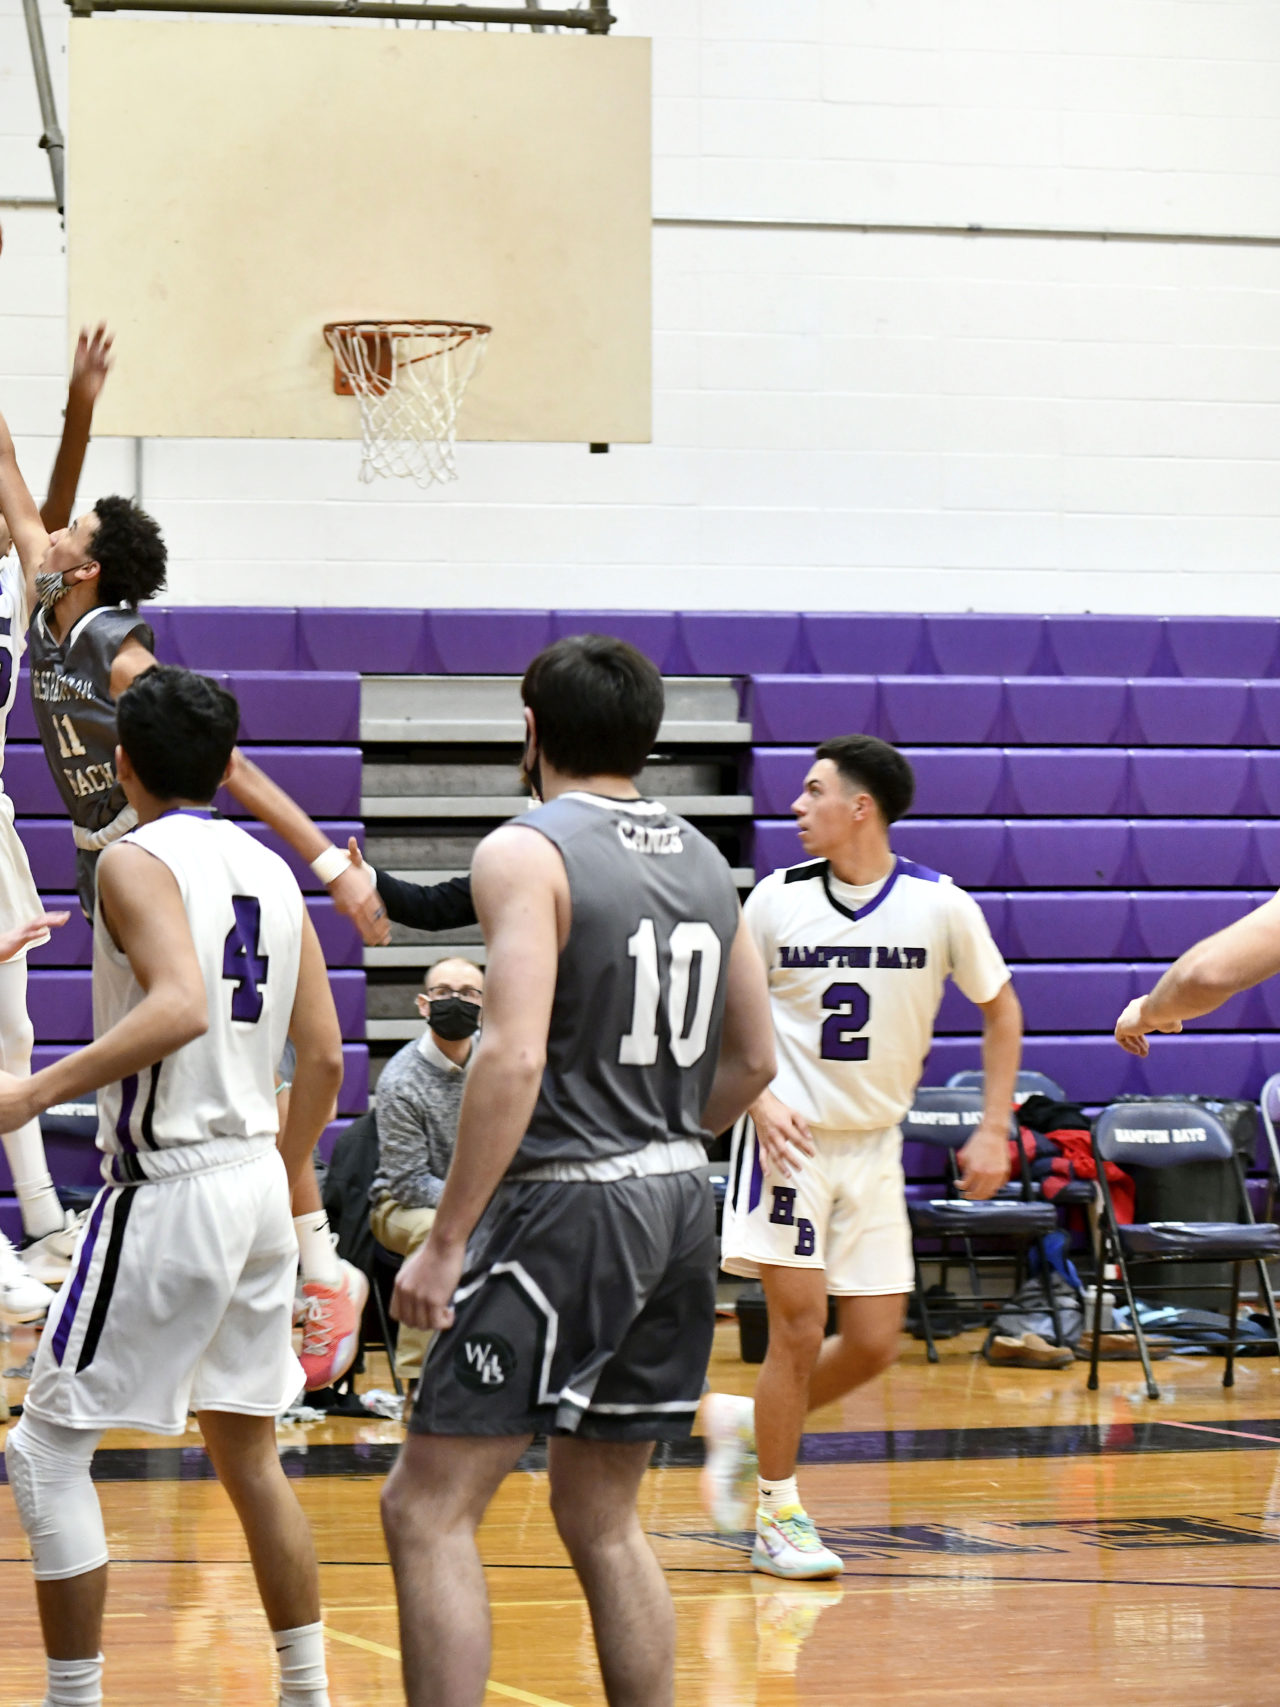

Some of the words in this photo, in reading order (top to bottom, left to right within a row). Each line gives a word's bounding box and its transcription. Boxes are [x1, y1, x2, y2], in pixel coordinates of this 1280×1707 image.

[52, 713, 87, 758] 11
[617, 820, 683, 854] CANES
[222, 894, 269, 1024] 4
[778, 946, 871, 969] HAMPTON
[875, 946, 927, 969] BAYS
[618, 918, 721, 1068] 10
[820, 982, 871, 1061] 2
[907, 1110, 960, 1126] HAMPTON
[961, 1111, 985, 1126] BAY
[1114, 1128, 1170, 1144] HAMPTON
[1171, 1127, 1207, 1144] BAYS
